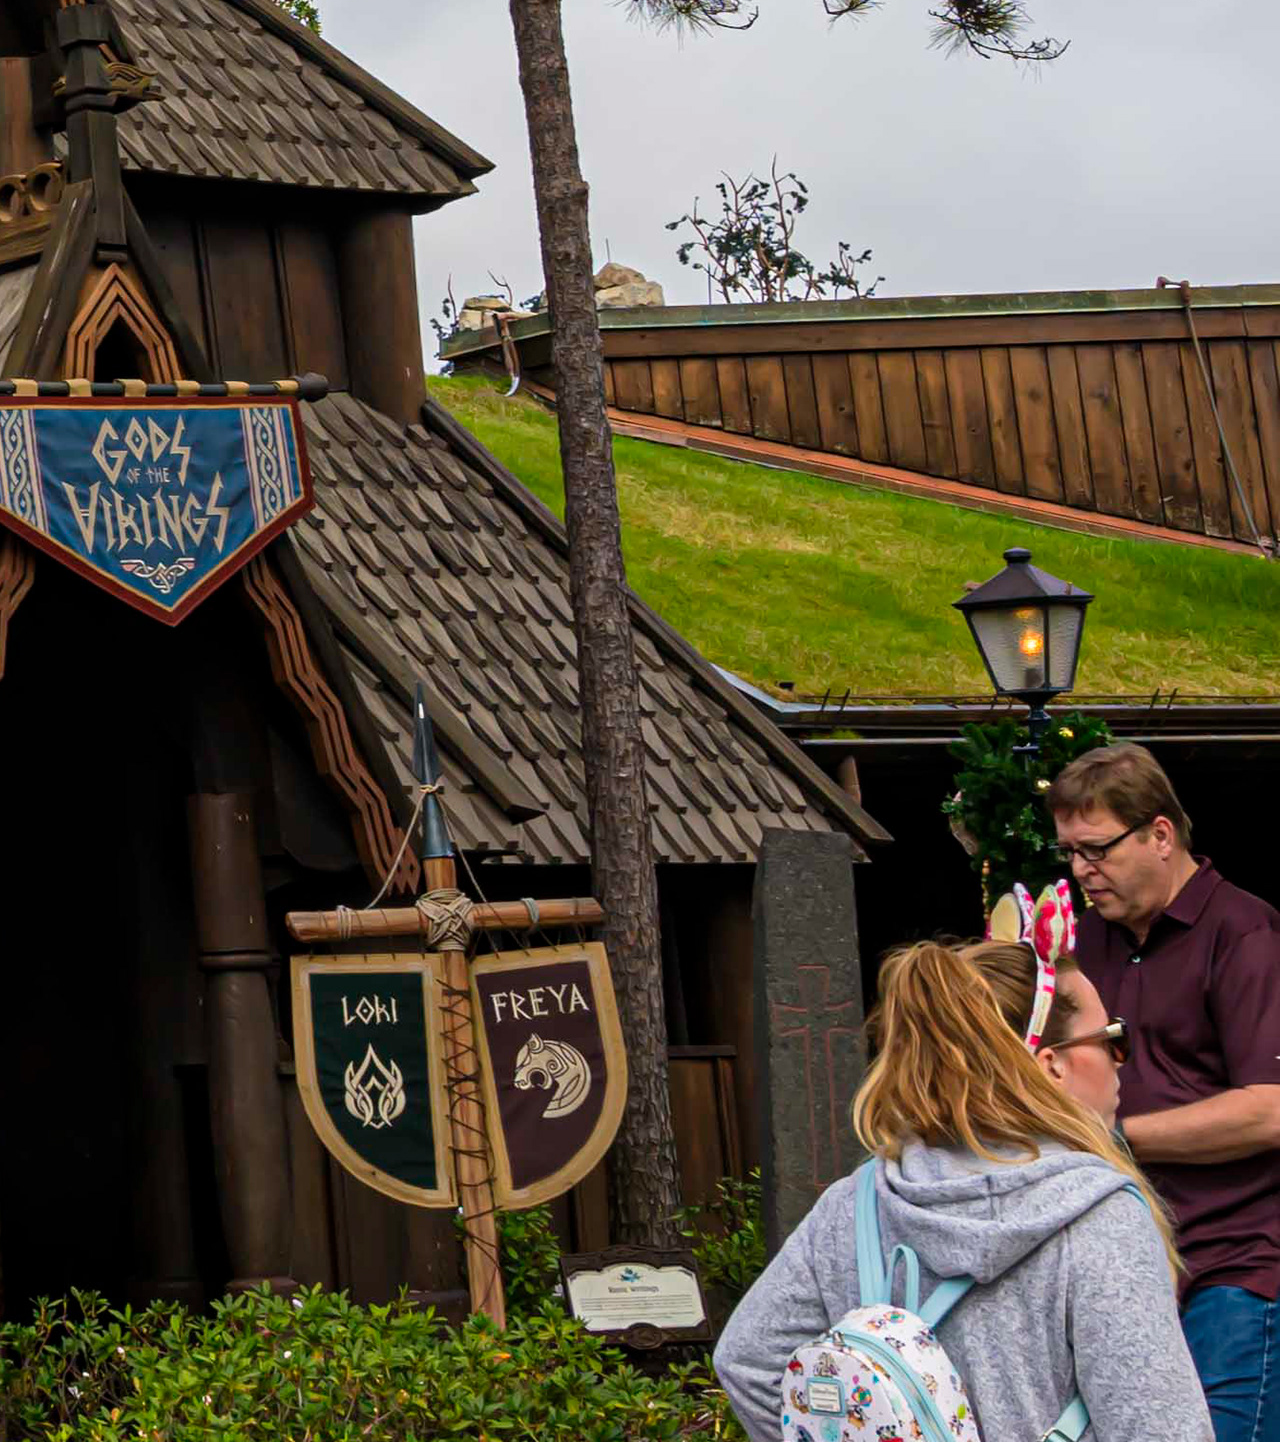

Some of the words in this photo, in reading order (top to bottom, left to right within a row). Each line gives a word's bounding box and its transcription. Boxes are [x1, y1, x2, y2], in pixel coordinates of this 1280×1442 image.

[92, 414, 190, 487] GODS
[126, 467, 141, 484] OF
[145, 466, 171, 484] THE
[61, 471, 230, 554] VIKINGS
[341, 994, 399, 1027] LOKI
[490, 983, 590, 1023] FREYA
